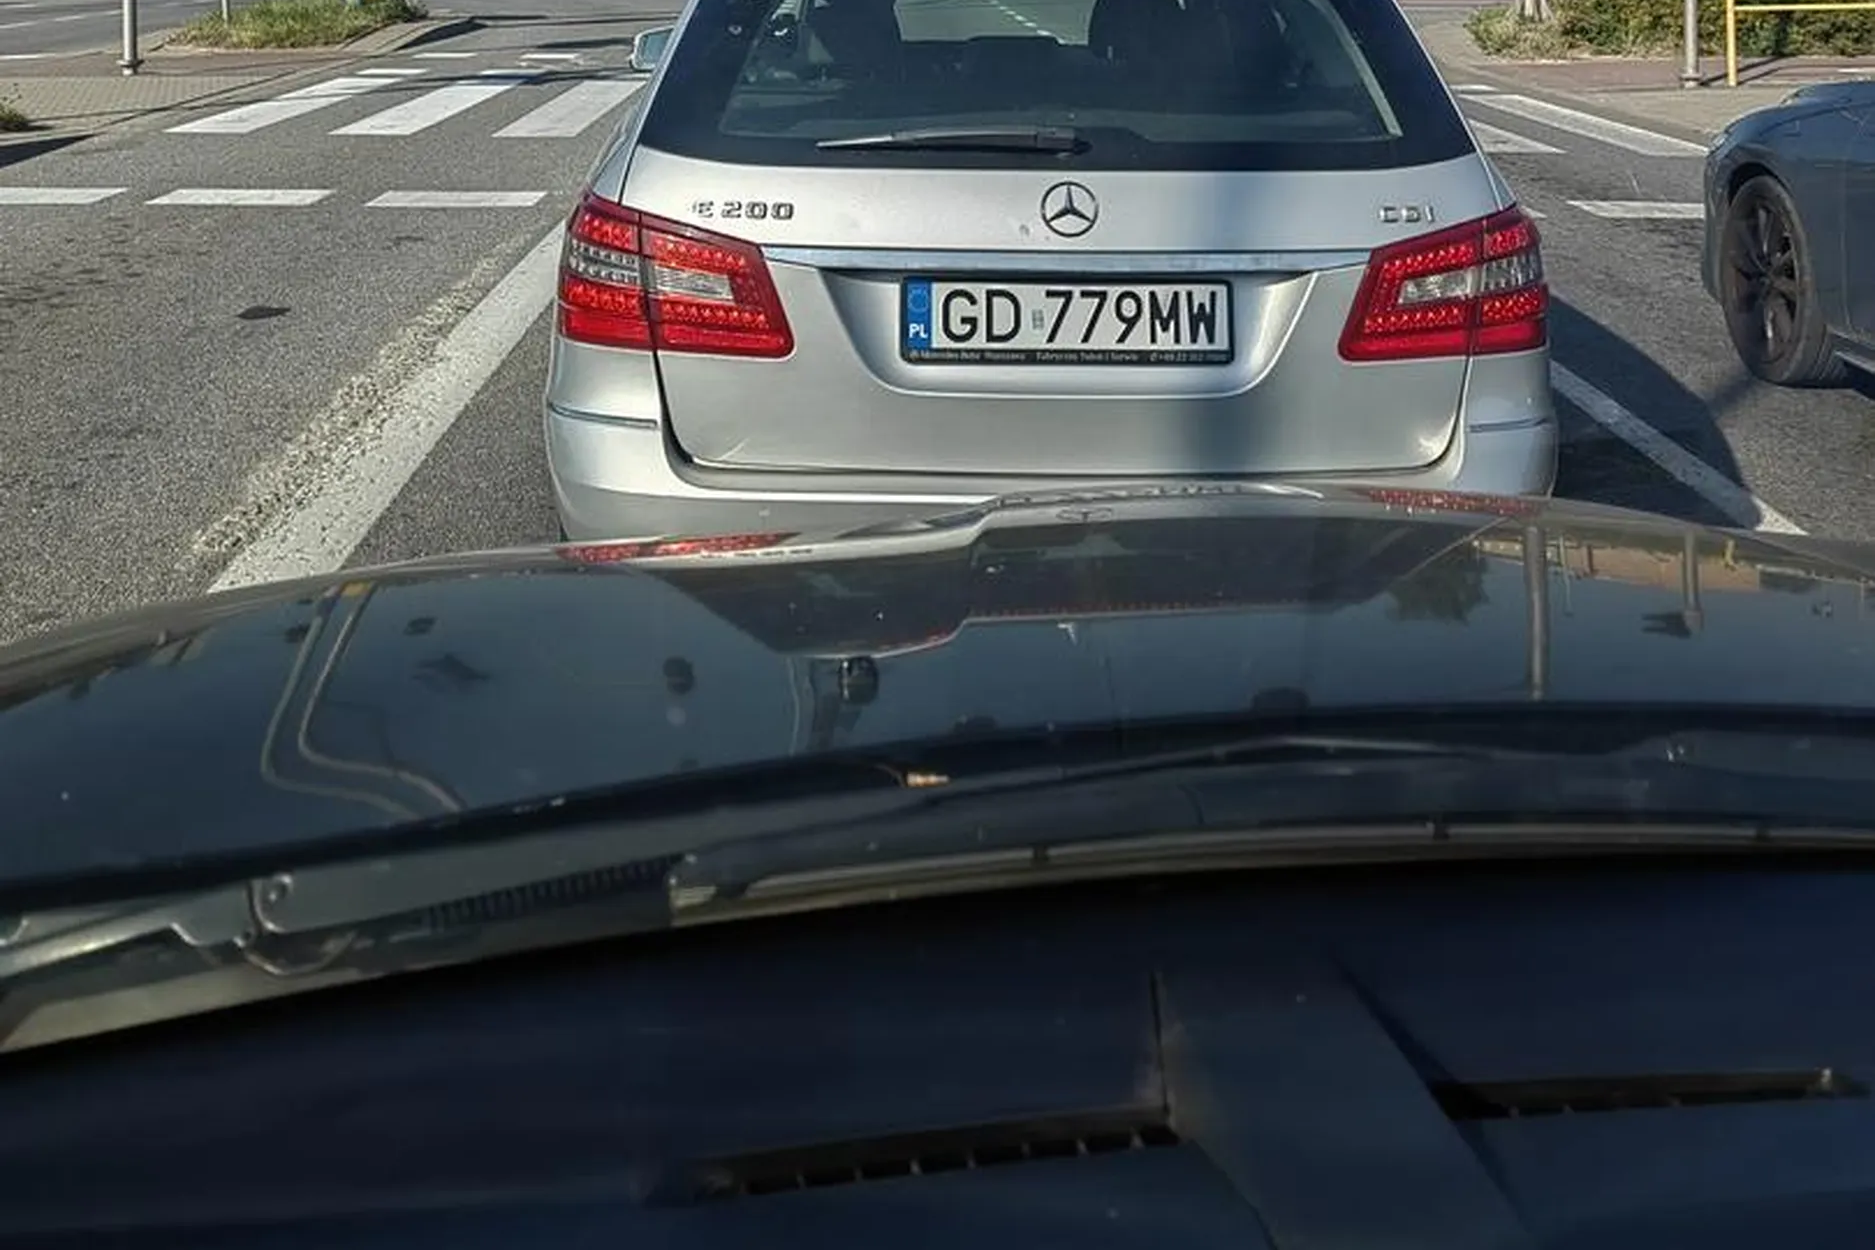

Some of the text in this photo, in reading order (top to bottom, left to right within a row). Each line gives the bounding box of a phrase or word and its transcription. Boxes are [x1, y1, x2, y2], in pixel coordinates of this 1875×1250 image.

[691, 200, 794, 220] E 200
[1378, 206, 1435, 222] CDI
[941, 289, 1217, 344] GD 779MW
[908, 323, 929, 338] PL
